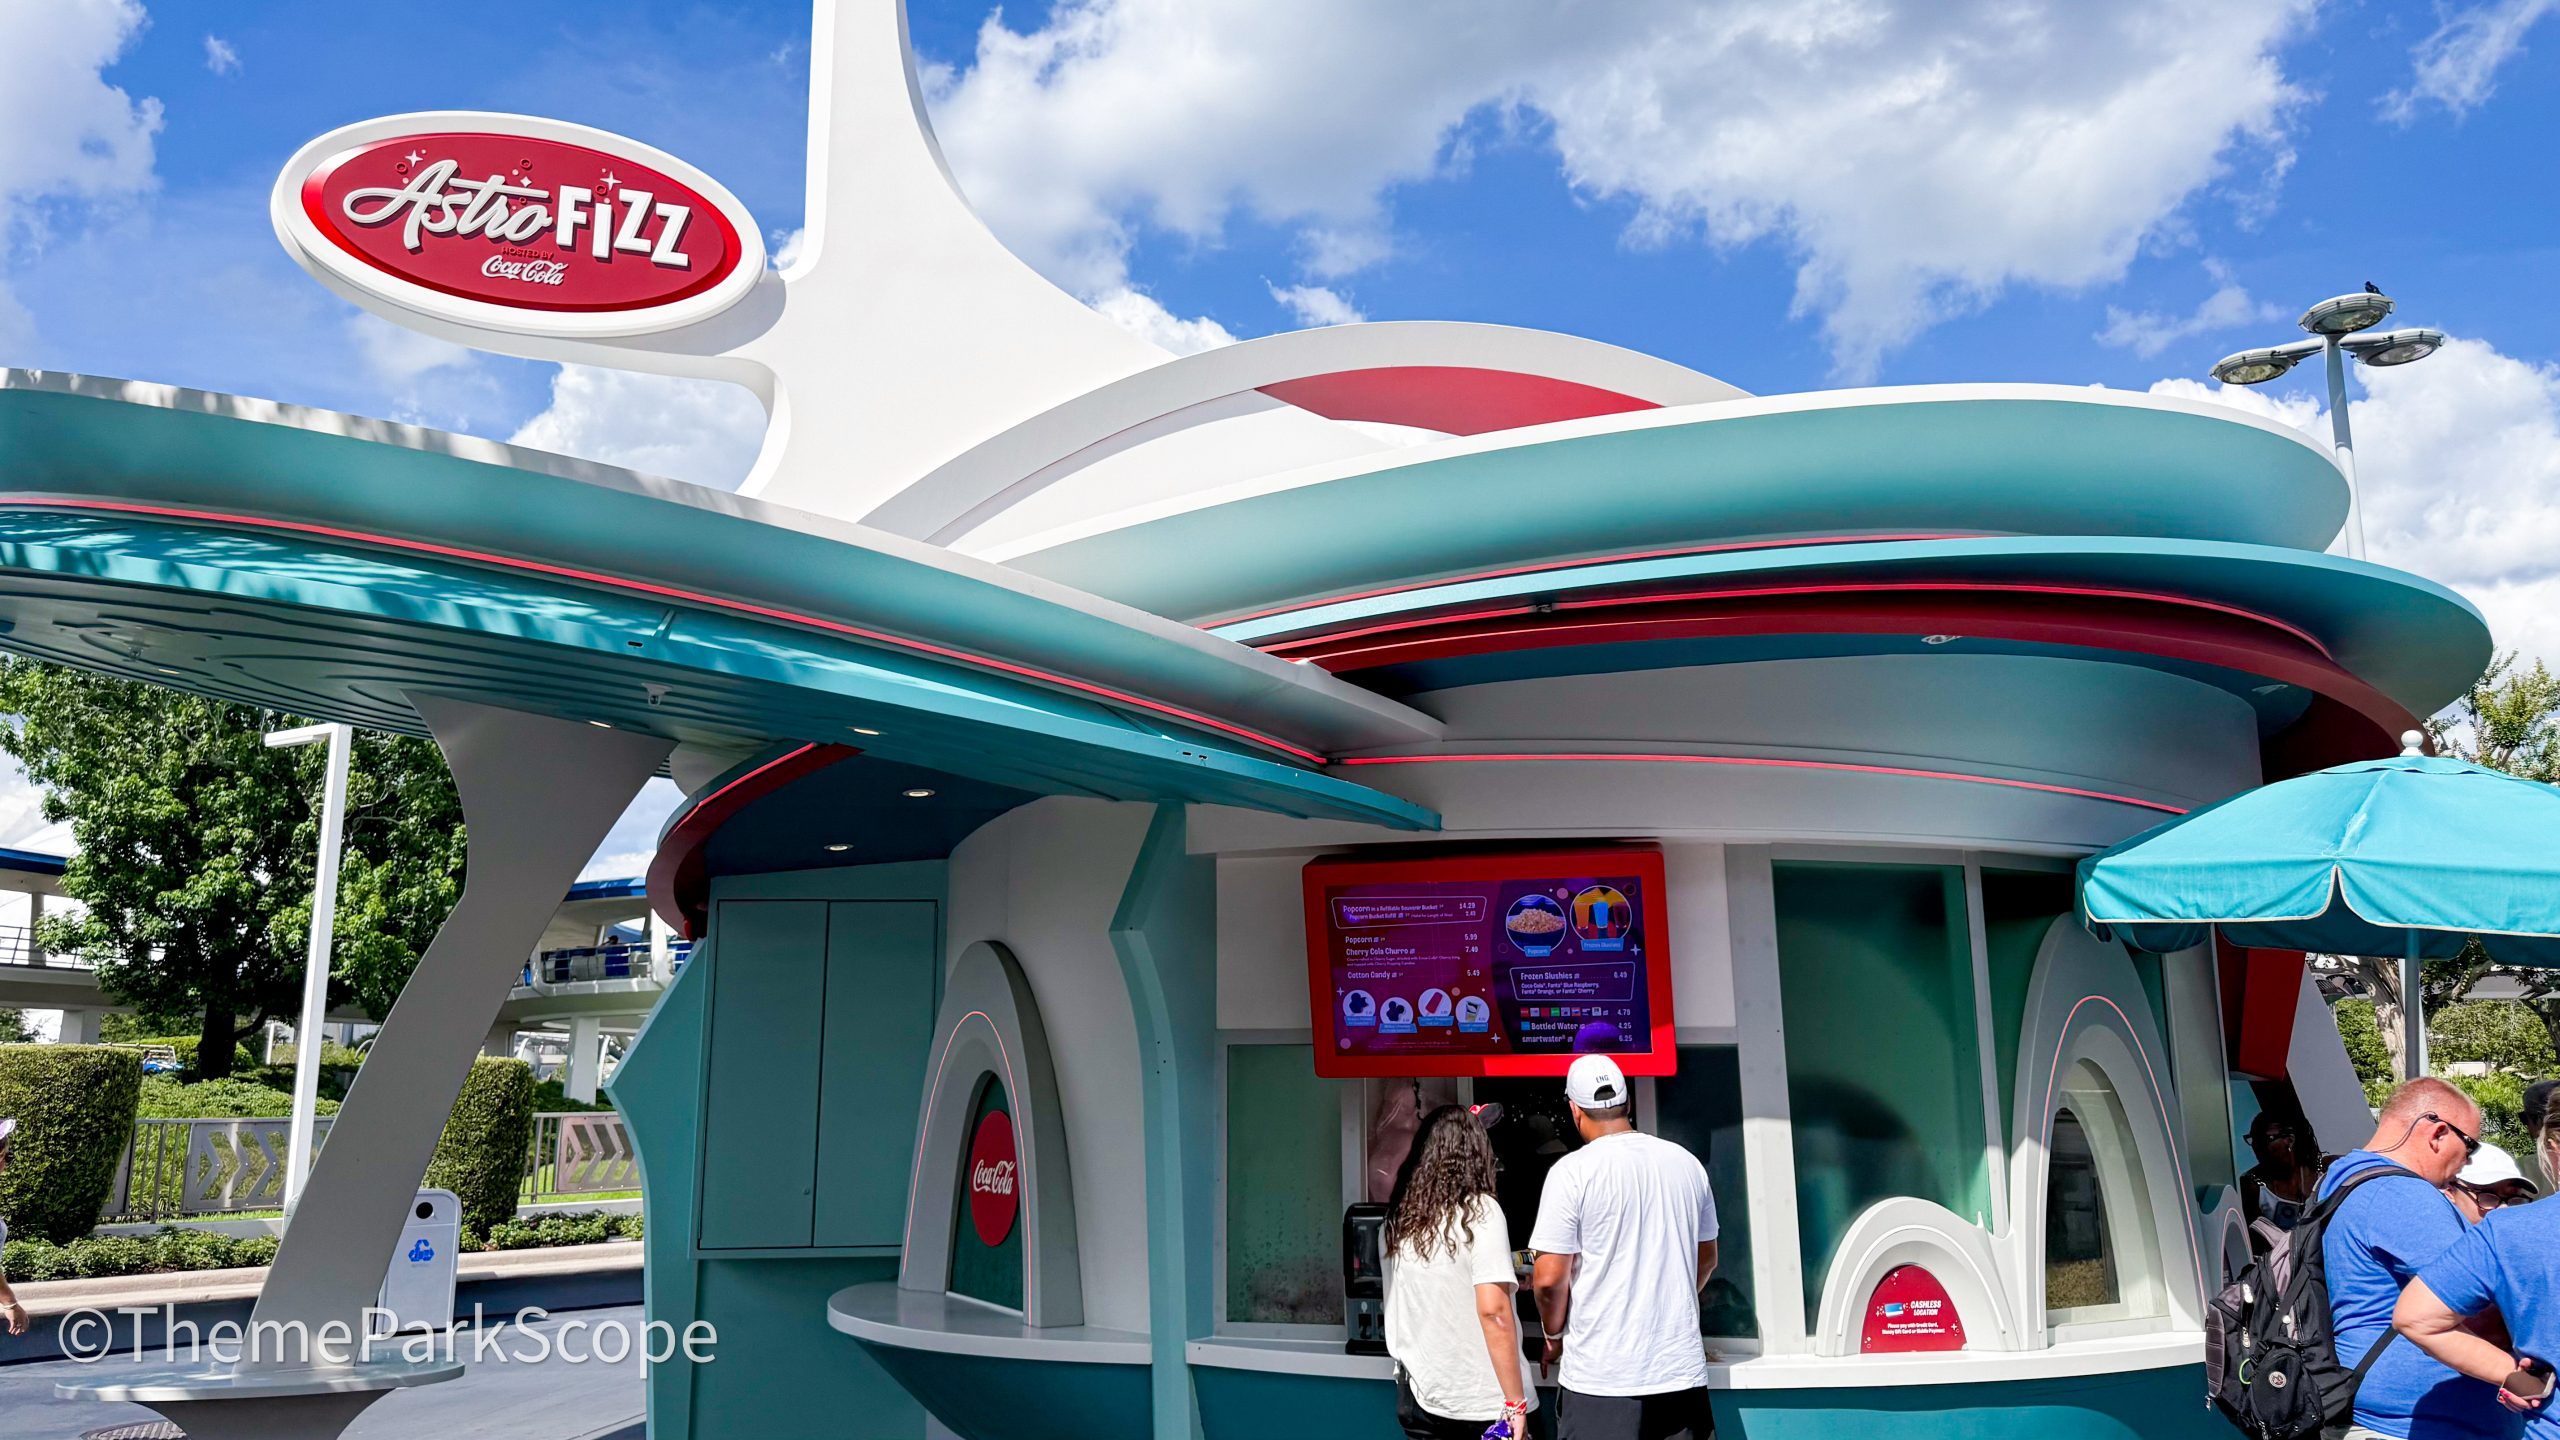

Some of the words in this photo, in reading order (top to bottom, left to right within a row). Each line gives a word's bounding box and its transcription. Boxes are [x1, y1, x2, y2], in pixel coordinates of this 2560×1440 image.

[343, 159, 553, 249] Astro
[502, 246, 541, 259] HOSTED
[541, 250, 554, 261] BY
[1343, 904, 1371, 913] Popcorn
[1345, 936, 1373, 944] Popcorn
[1346, 948, 1369, 957] Cherry
[1384, 947, 1409, 955] Churro
[1347, 971, 1370, 979] Cotton
[1370, 971, 1390, 980] Candy
[1520, 972, 1544, 980] Frozen
[1531, 1022, 1556, 1030] Bottled
[1556, 1022, 1579, 1030] Water
[1910, 1300, 1942, 1309] CASHLESS
[1913, 1308, 1938, 1316] LOCATION
